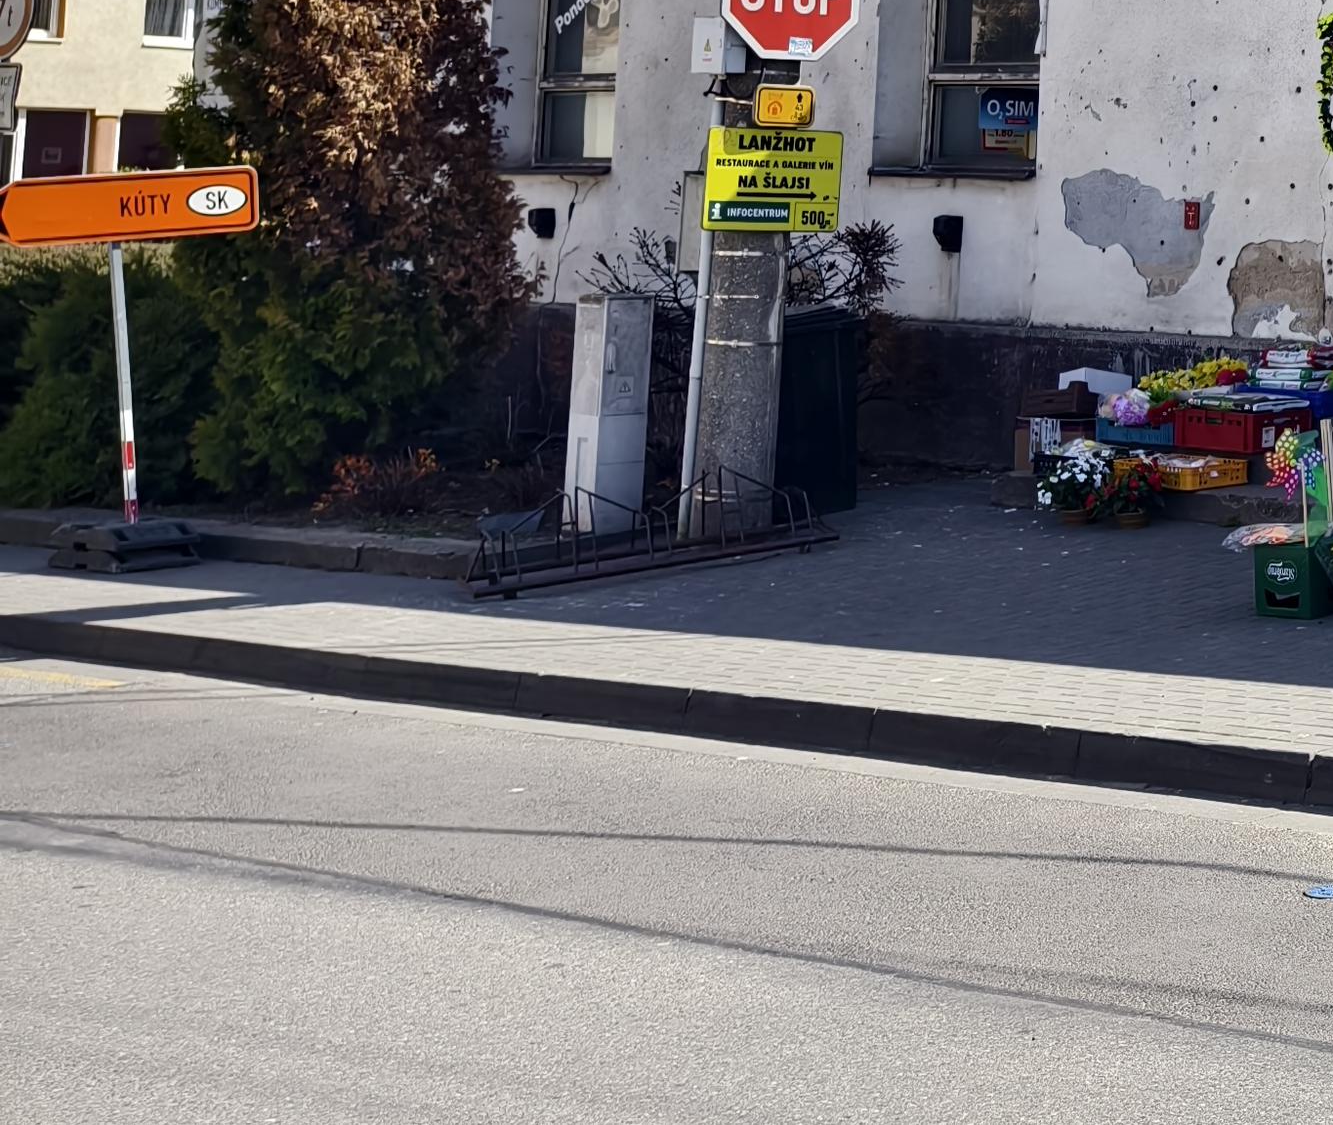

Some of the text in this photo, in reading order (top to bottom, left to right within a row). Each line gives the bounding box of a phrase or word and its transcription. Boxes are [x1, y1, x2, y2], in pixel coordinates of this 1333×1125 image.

[1005, 100, 1034, 116] SIM
[738, 131, 815, 152] LANŽHOT
[716, 158, 770, 168] RESTAURACE
[782, 161, 816, 169] GALERIE
[738, 172, 810, 189] NA ŠLAJSI
[119, 190, 229, 217] KÚTY SK
[727, 208, 788, 218] INFOCENTRUM
